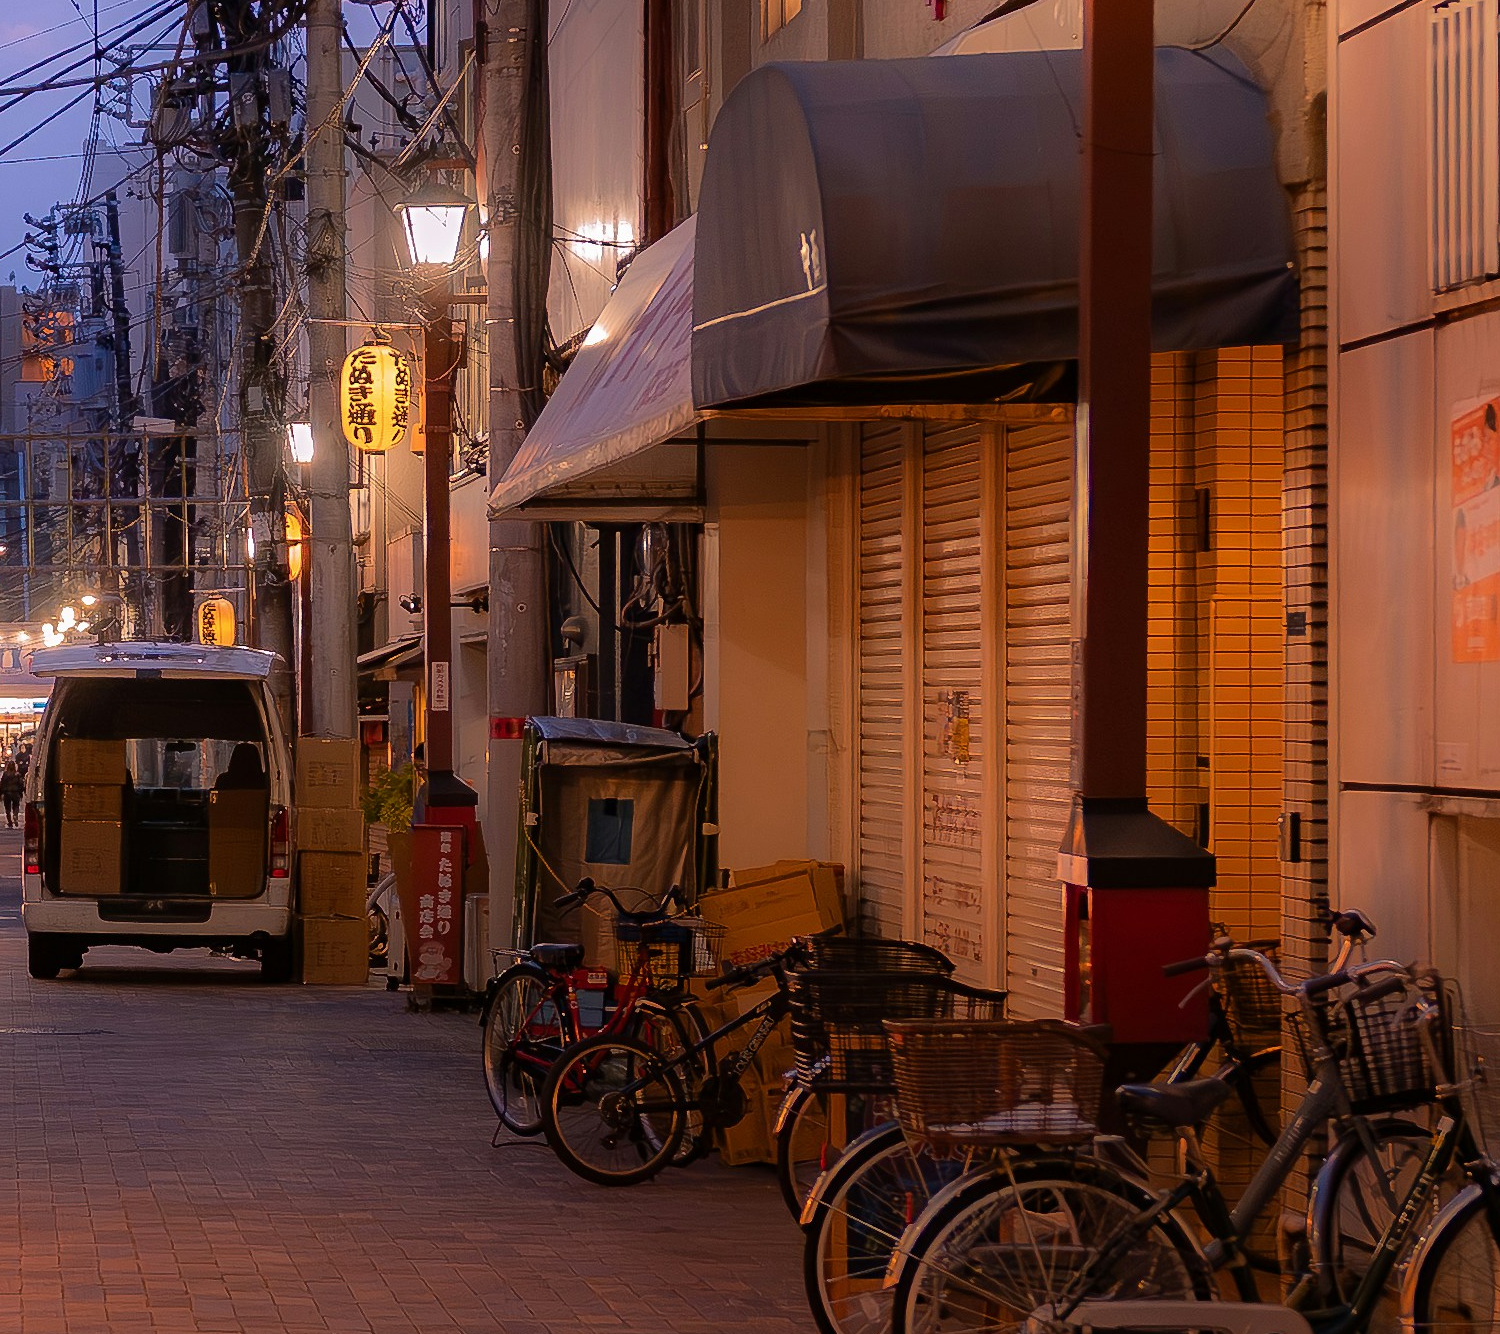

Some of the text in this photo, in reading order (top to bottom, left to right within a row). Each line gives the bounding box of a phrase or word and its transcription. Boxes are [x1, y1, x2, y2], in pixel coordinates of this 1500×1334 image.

[347, 350, 378, 444] たぬき通り
[419, 894, 435, 939] 商店会
[436, 857, 453, 936] たぬき通り
